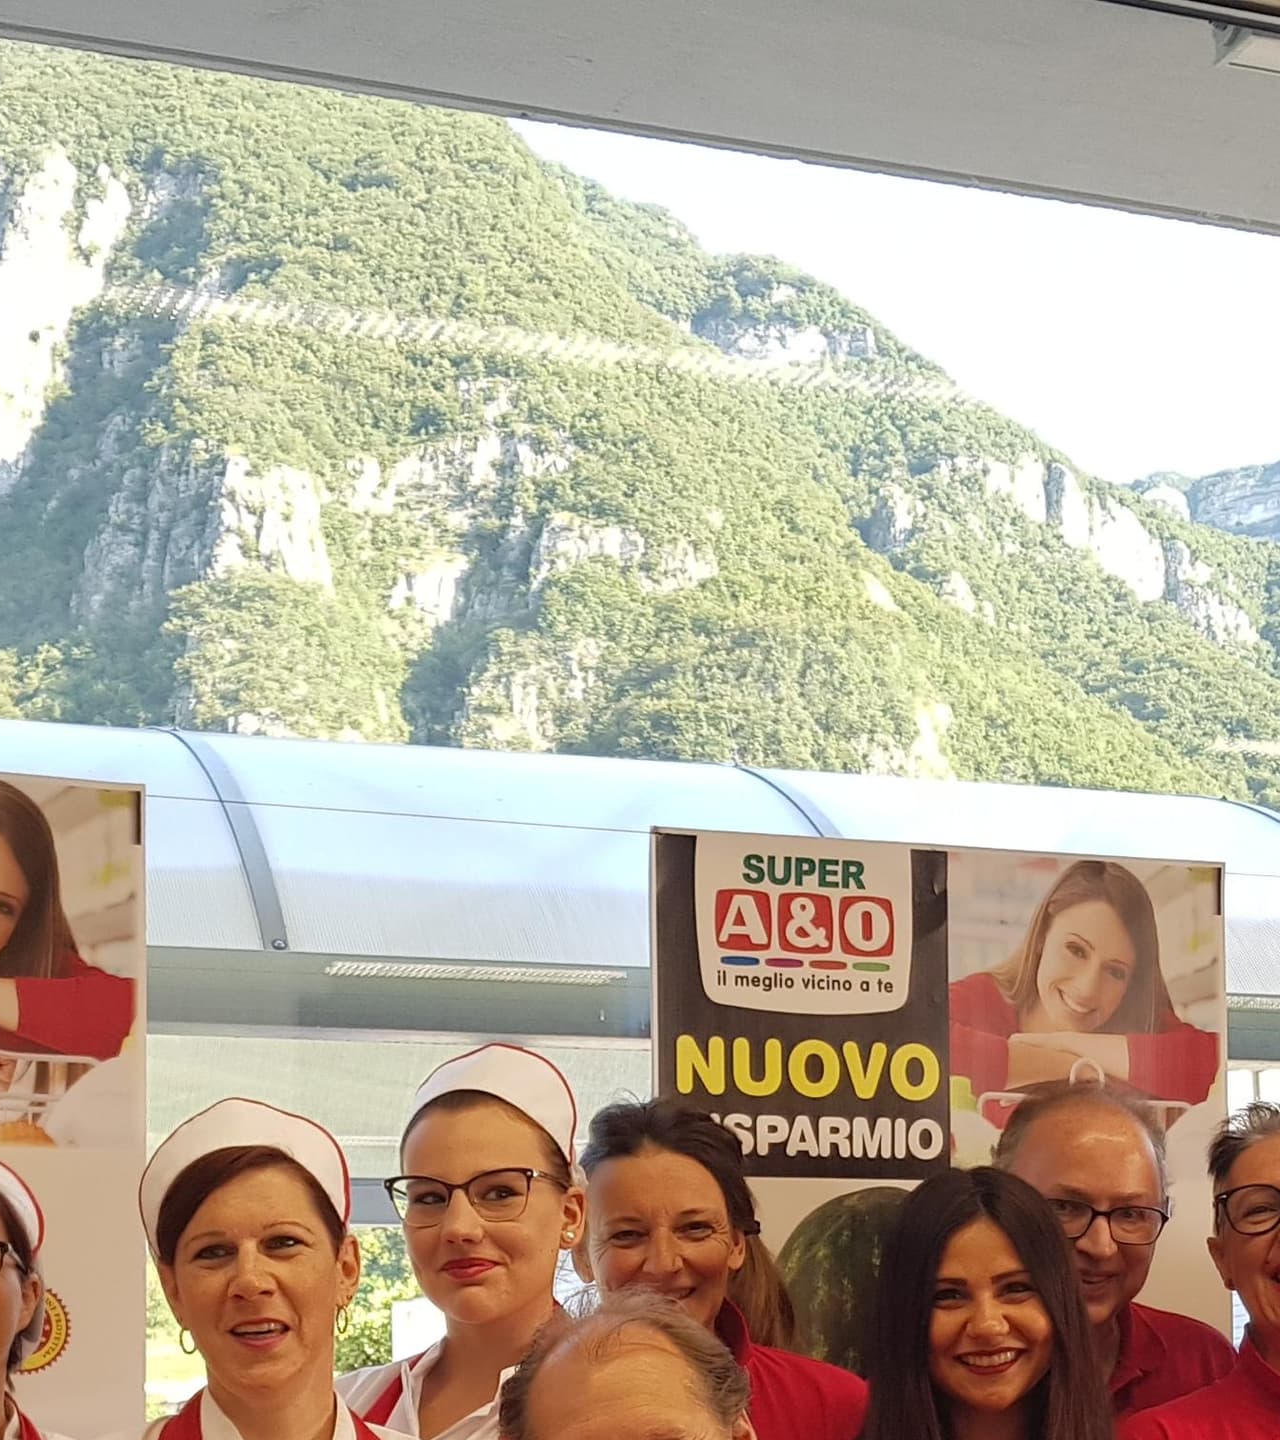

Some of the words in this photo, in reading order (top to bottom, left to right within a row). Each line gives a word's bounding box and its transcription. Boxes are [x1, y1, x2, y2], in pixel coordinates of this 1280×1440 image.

[741, 853, 867, 890] SUPER
[717, 892, 893, 953] A&O
[716, 970, 727, 987] il
[734, 971, 795, 992] meglio
[801, 973, 853, 992] vicino
[860, 980, 870, 992] a
[876, 977, 894, 994] te
[675, 1034, 941, 1102] NUOVO
[709, 1112, 944, 1161] SPARMIO
